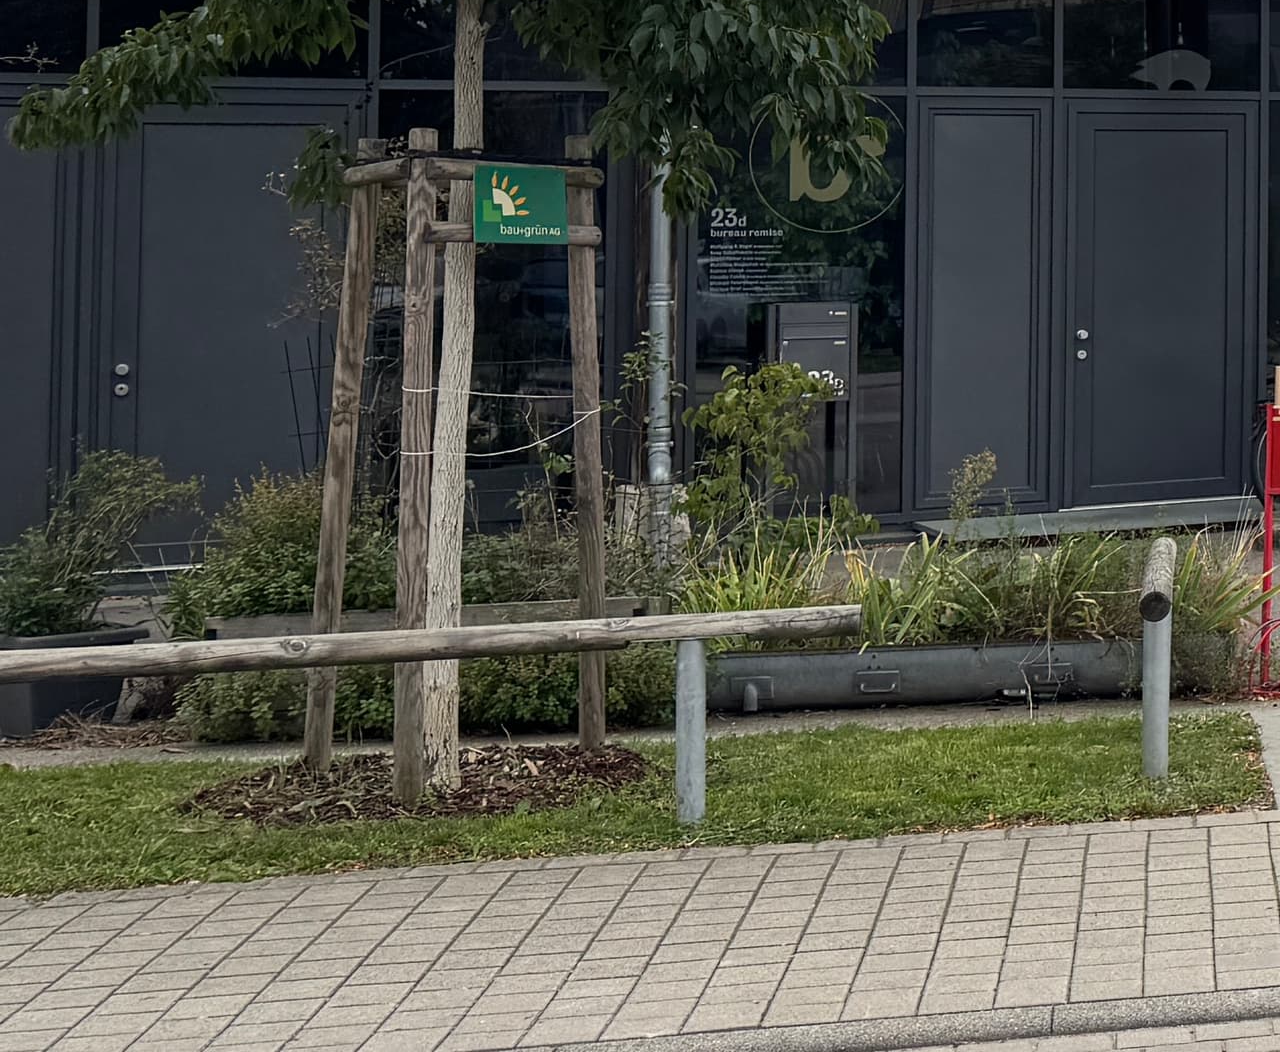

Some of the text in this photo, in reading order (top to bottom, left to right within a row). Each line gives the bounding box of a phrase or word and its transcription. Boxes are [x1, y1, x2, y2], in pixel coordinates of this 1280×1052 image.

[711, 208, 747, 227] 23d
[549, 228, 561, 236] AG
[710, 229, 784, 237] bureau remise
